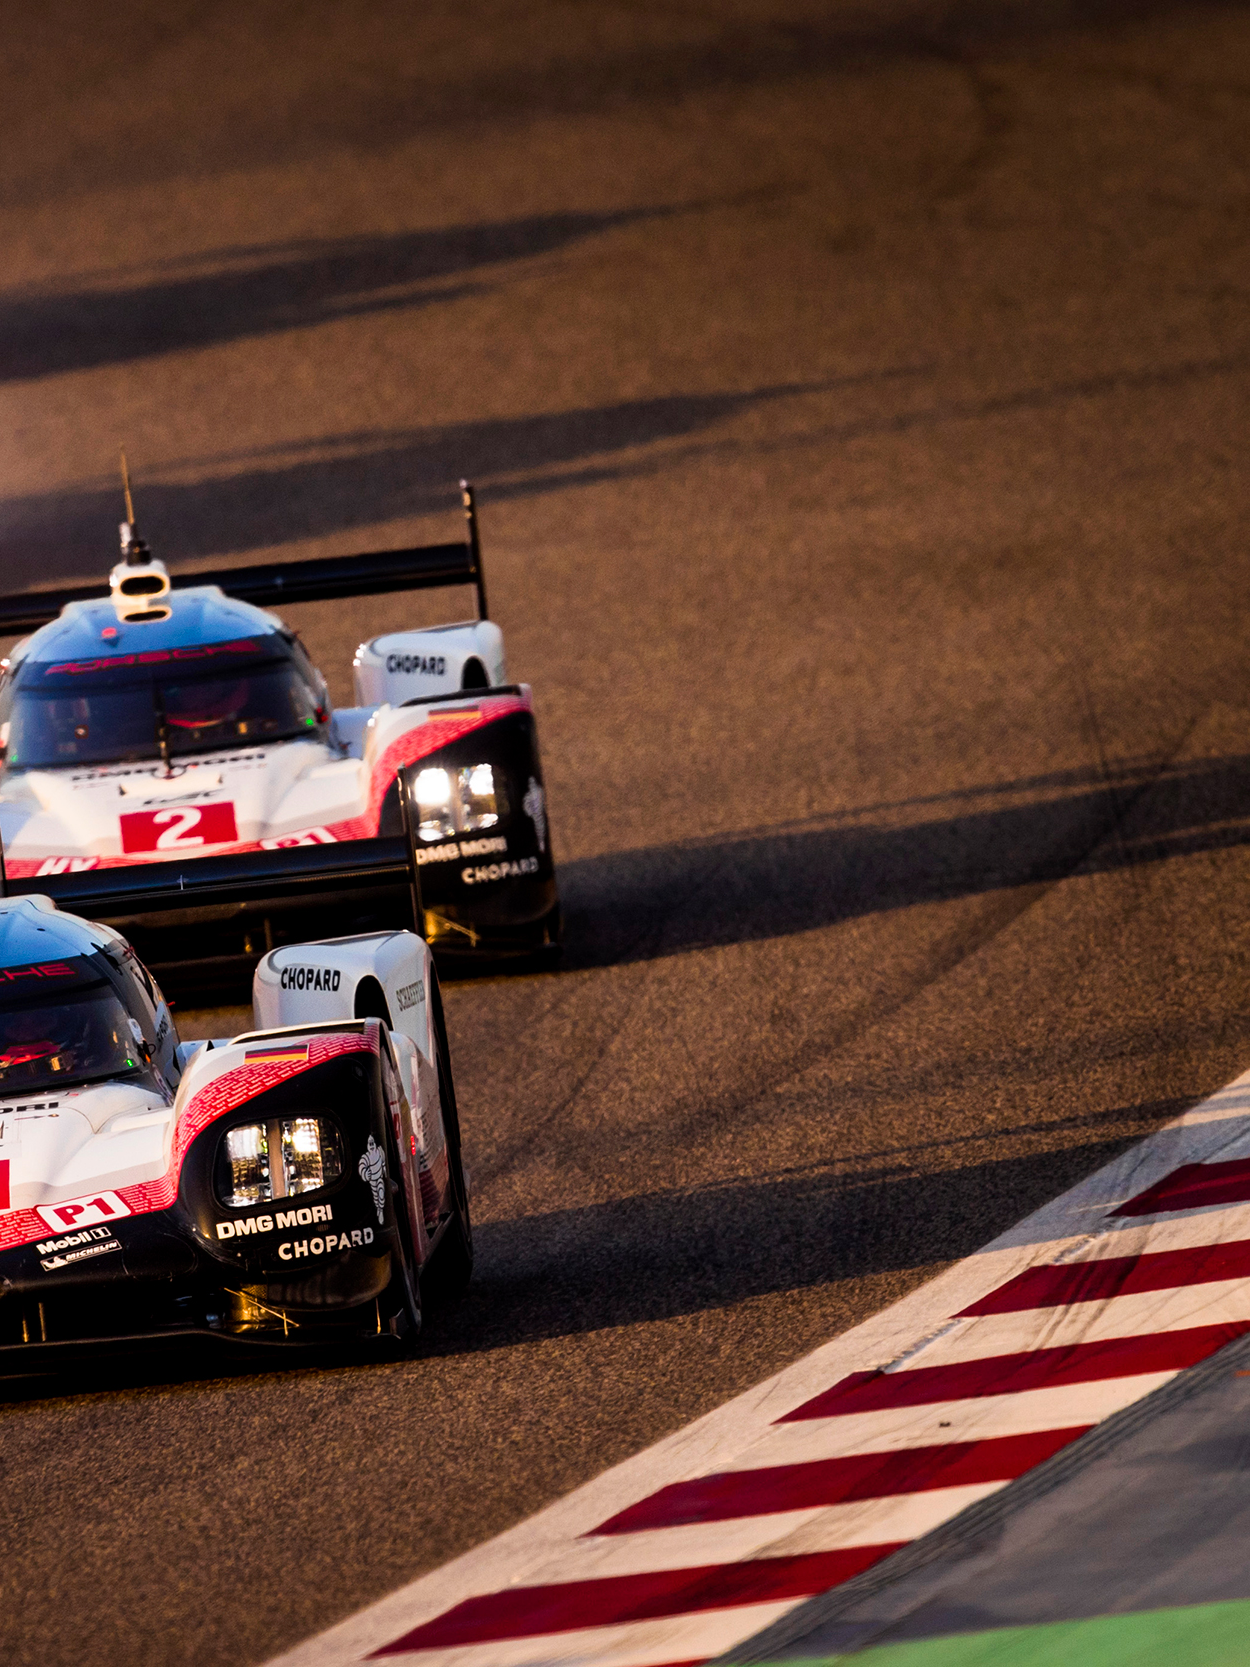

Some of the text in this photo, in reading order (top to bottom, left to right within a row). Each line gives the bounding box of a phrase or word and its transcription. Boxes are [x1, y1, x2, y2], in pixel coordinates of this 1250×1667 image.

[387, 653, 446, 676] CHOPARD
[152, 807, 204, 850] 2
[415, 842, 460, 865] DMG
[461, 856, 539, 885] CHOPARD
[280, 967, 341, 992] CHOPARD
[52, 1197, 116, 1226] P1
[216, 1204, 333, 1239] DMG MORI
[36, 1231, 92, 1255] Mobil
[66, 1241, 118, 1261] MICHELIN
[278, 1227, 374, 1261] CHOPARD
